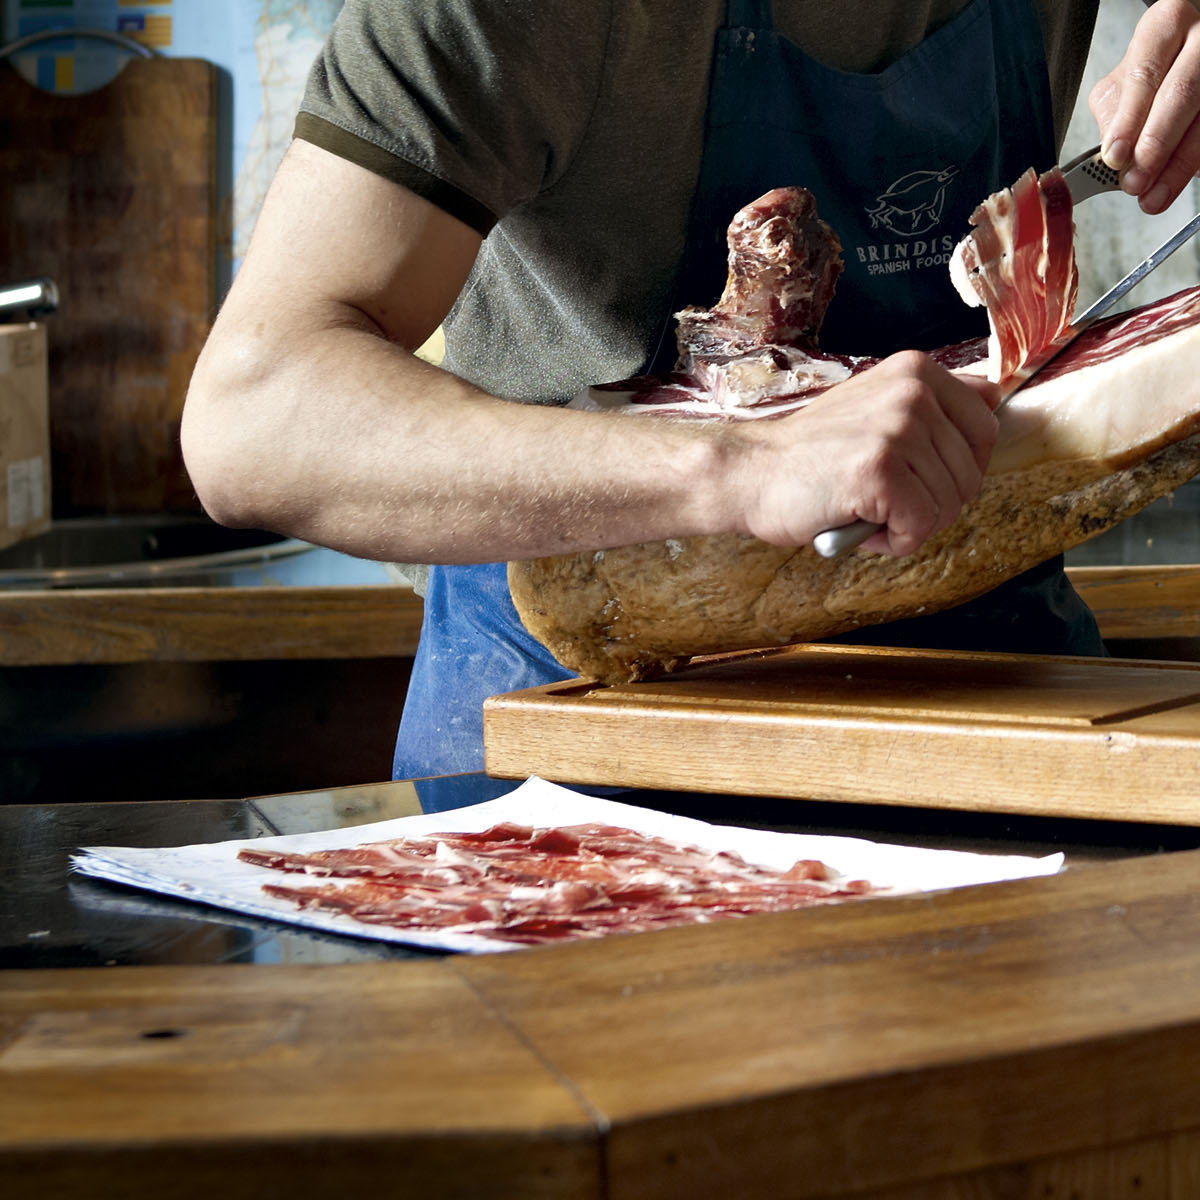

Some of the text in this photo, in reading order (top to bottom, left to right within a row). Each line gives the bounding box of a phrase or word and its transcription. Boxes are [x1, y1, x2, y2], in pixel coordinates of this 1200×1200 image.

[856, 233, 964, 262] BRINDIS
[867, 253, 953, 275] SPANISH FOOD
